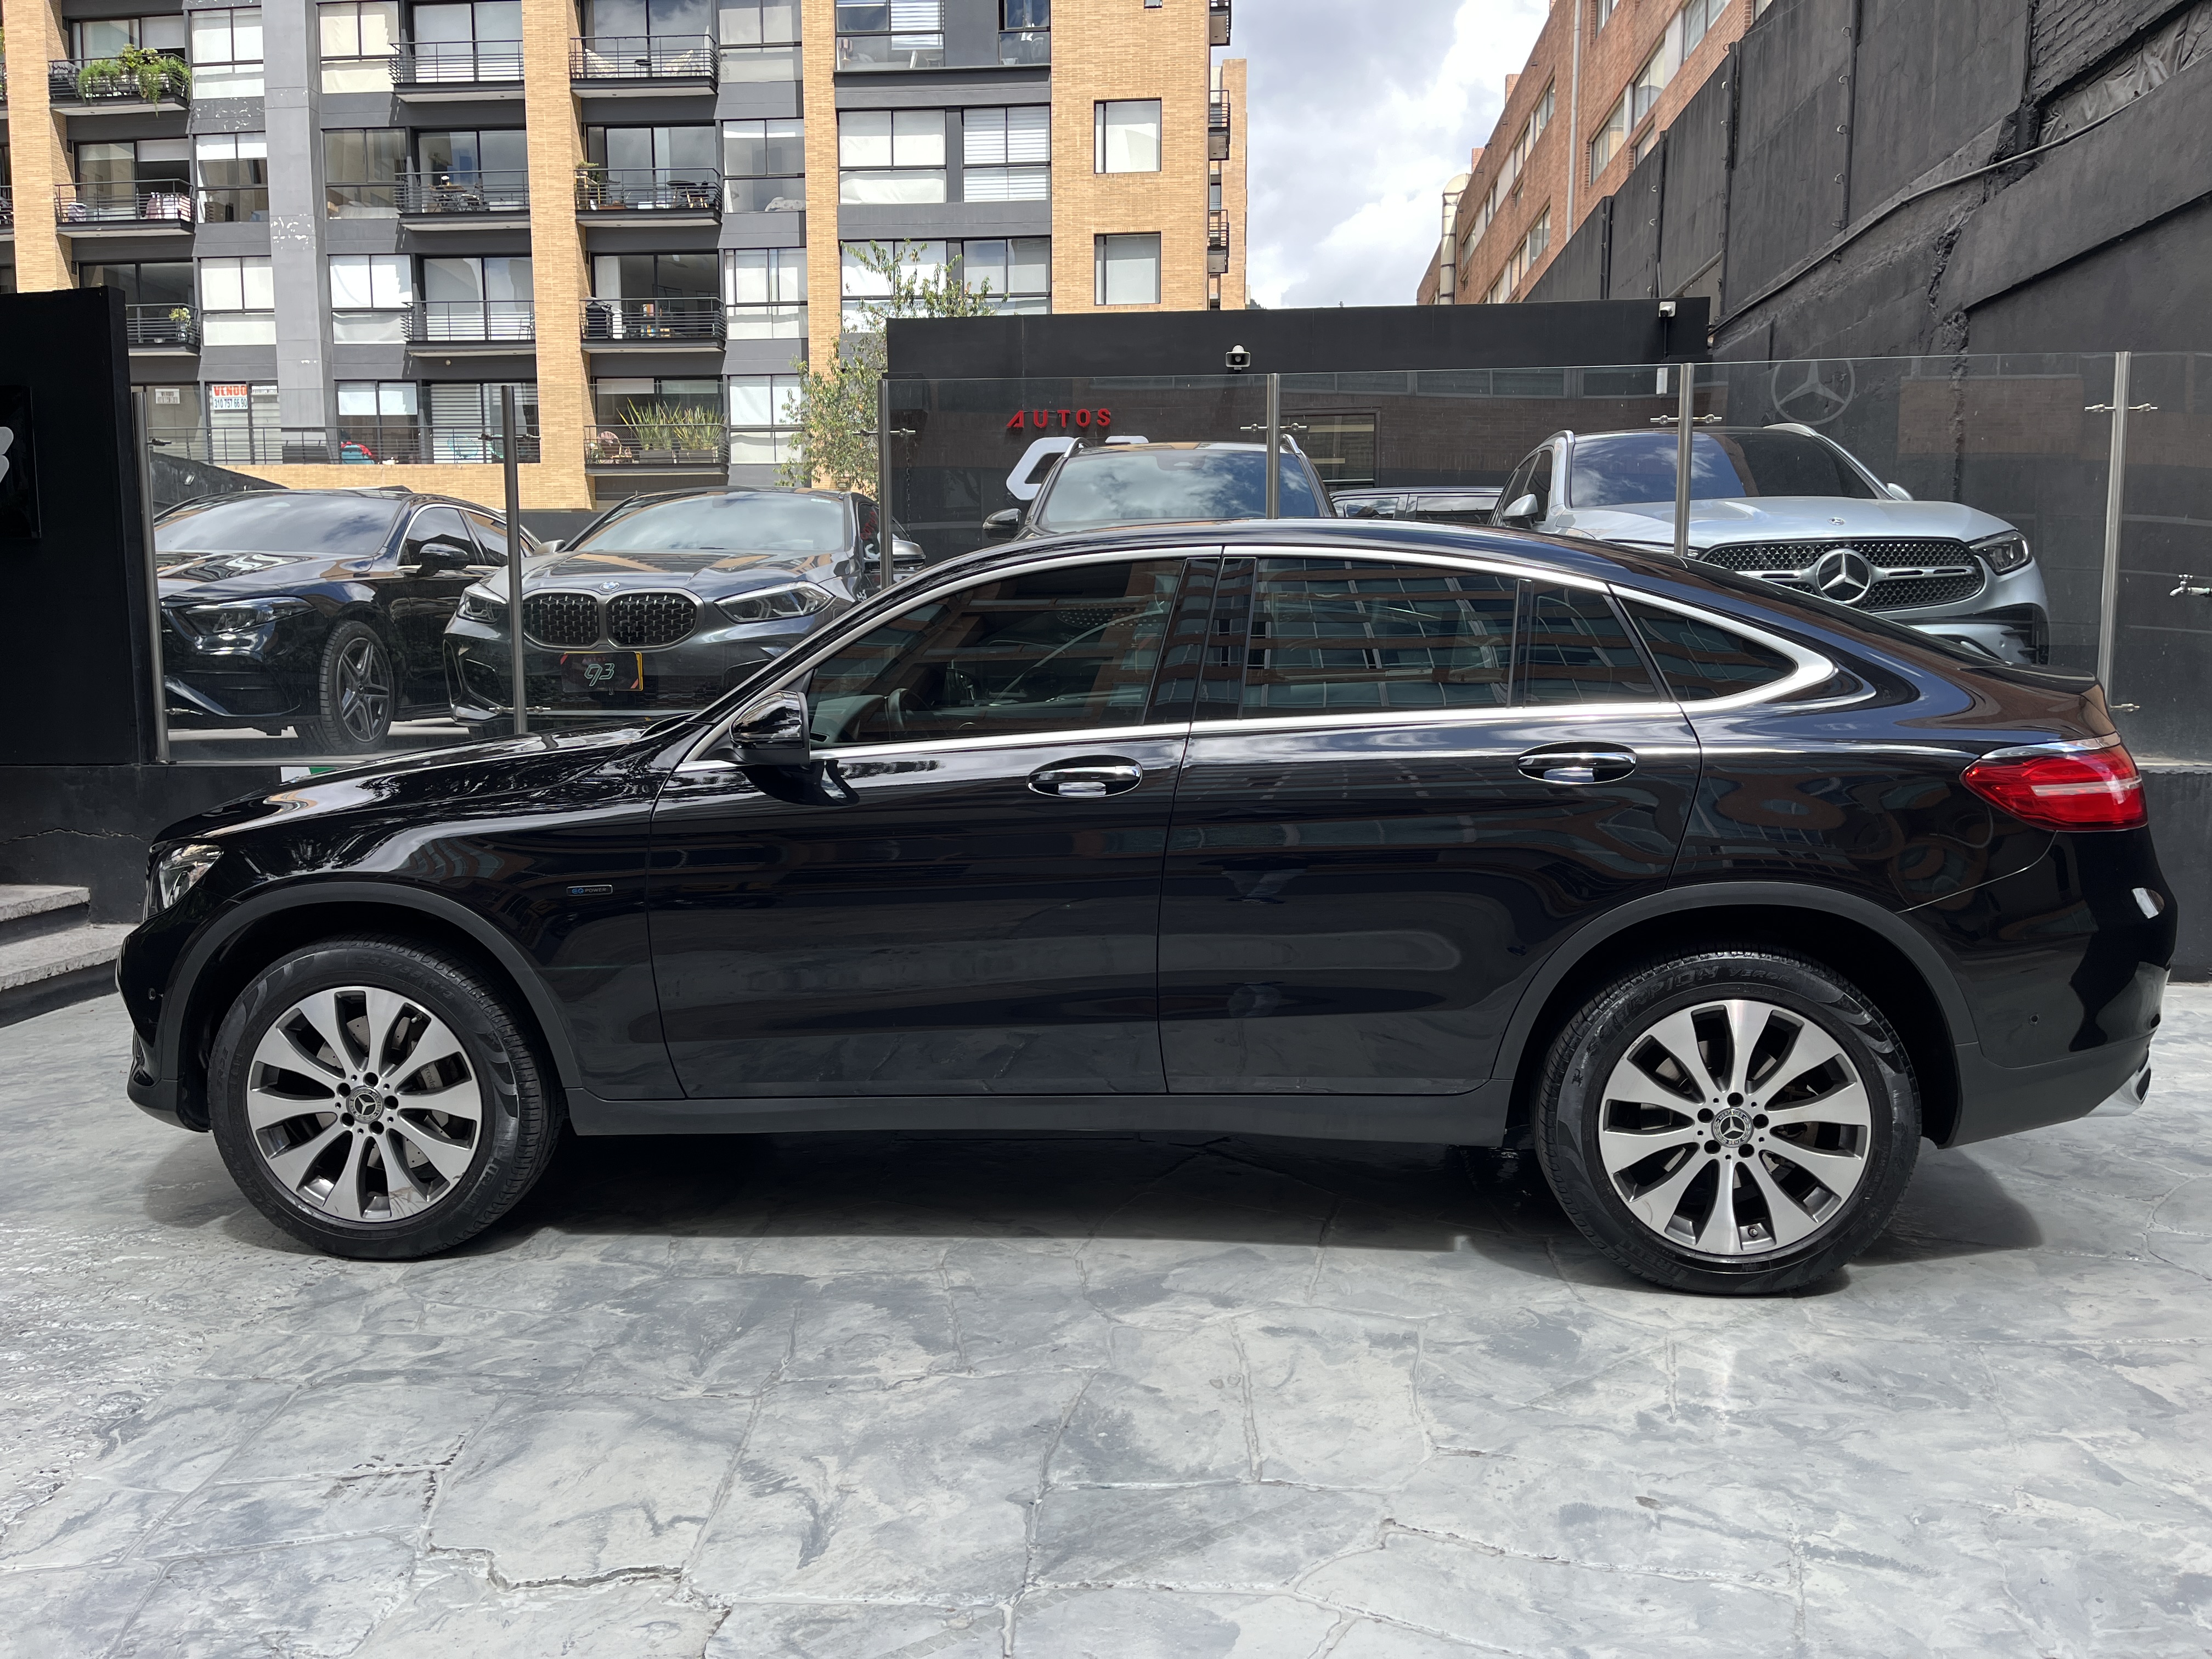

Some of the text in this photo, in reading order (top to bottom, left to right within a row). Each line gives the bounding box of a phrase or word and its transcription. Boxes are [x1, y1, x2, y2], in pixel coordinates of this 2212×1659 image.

[213, 385, 247, 396] VENDO
[215, 399, 223, 408] 310
[224, 398, 233, 408] 757
[1006, 408, 1111, 428] AUTOS
[584, 663, 614, 686] 93
[1718, 1110, 1743, 1120] MERCEDES
